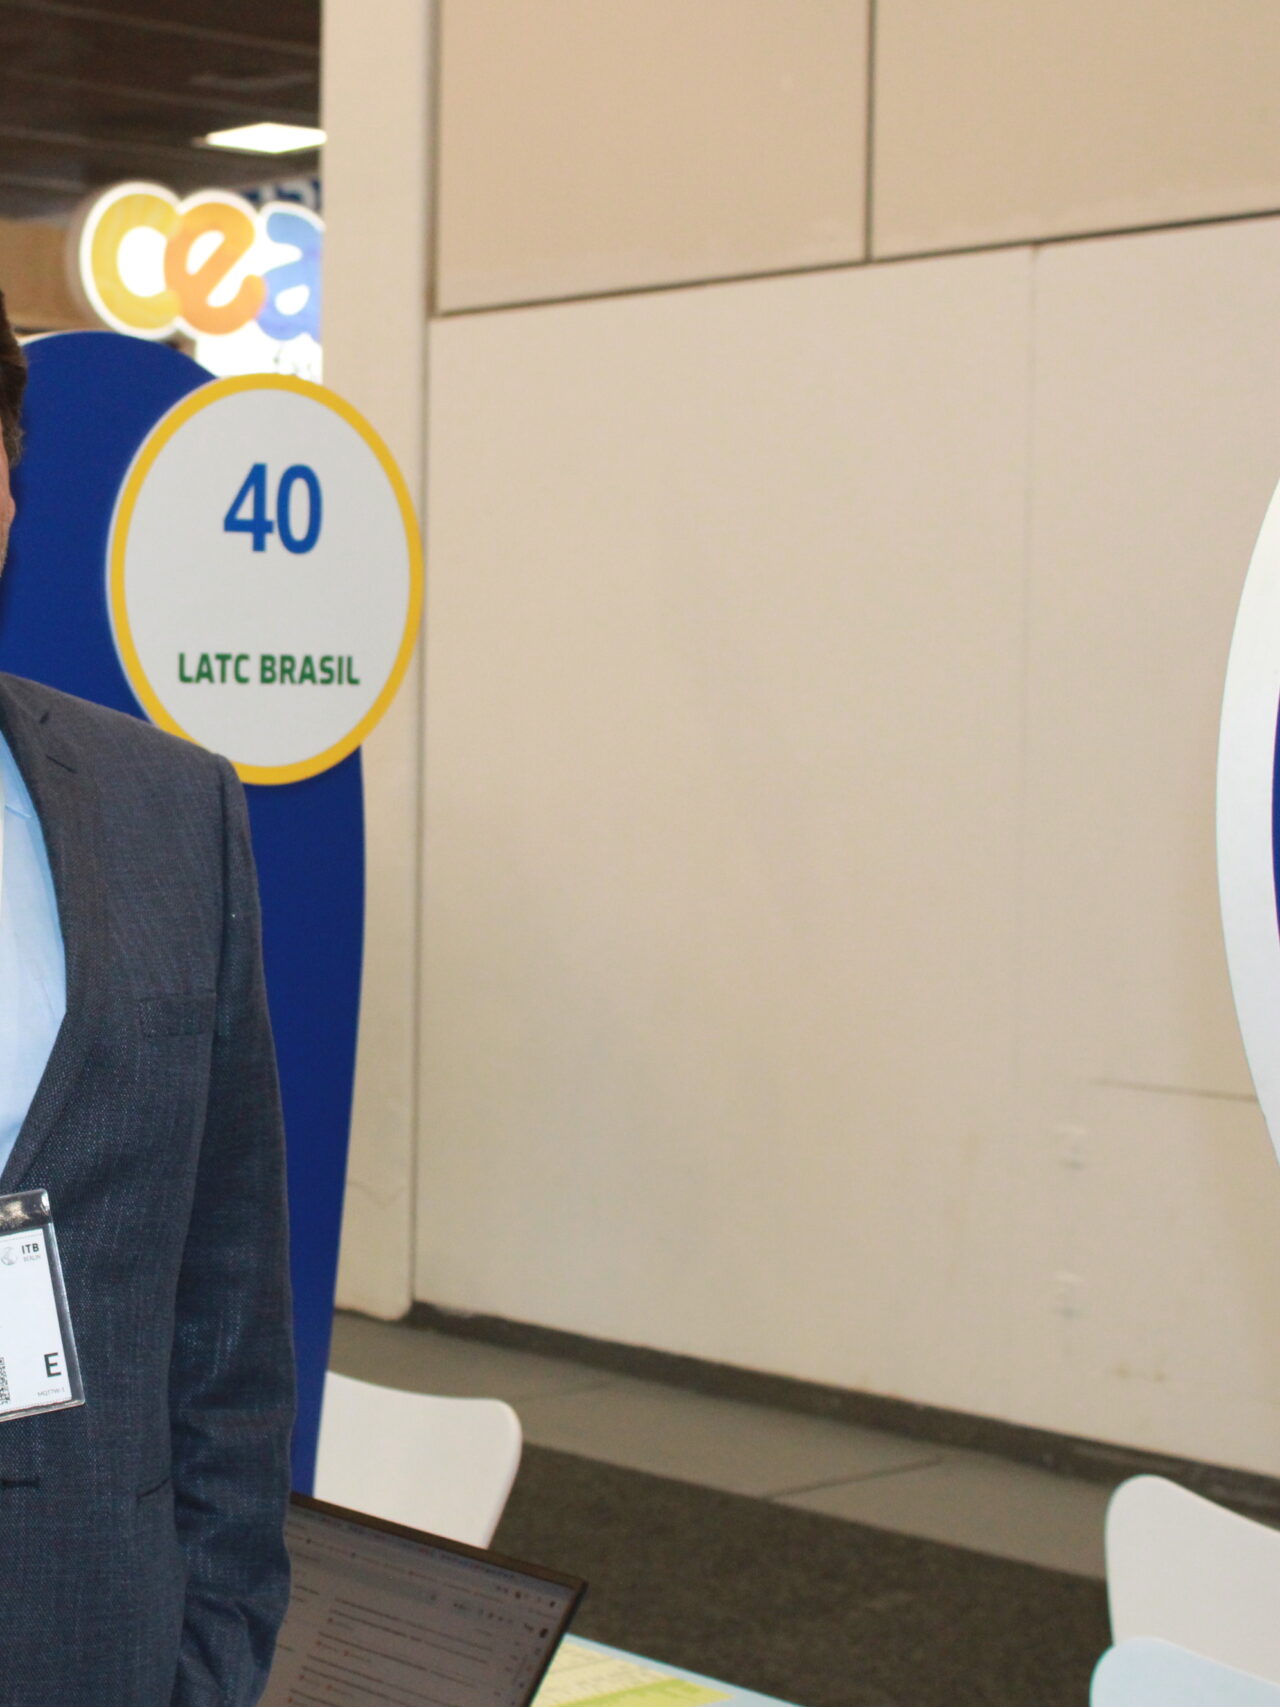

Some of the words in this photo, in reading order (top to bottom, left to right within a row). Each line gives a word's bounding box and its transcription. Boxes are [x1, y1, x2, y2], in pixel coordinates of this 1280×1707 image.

[223, 462, 323, 554] 40
[178, 653, 250, 684] LATC
[260, 654, 360, 685] BRASIL
[21, 1243, 40, 1254] ITB
[43, 1352, 62, 1378] E
